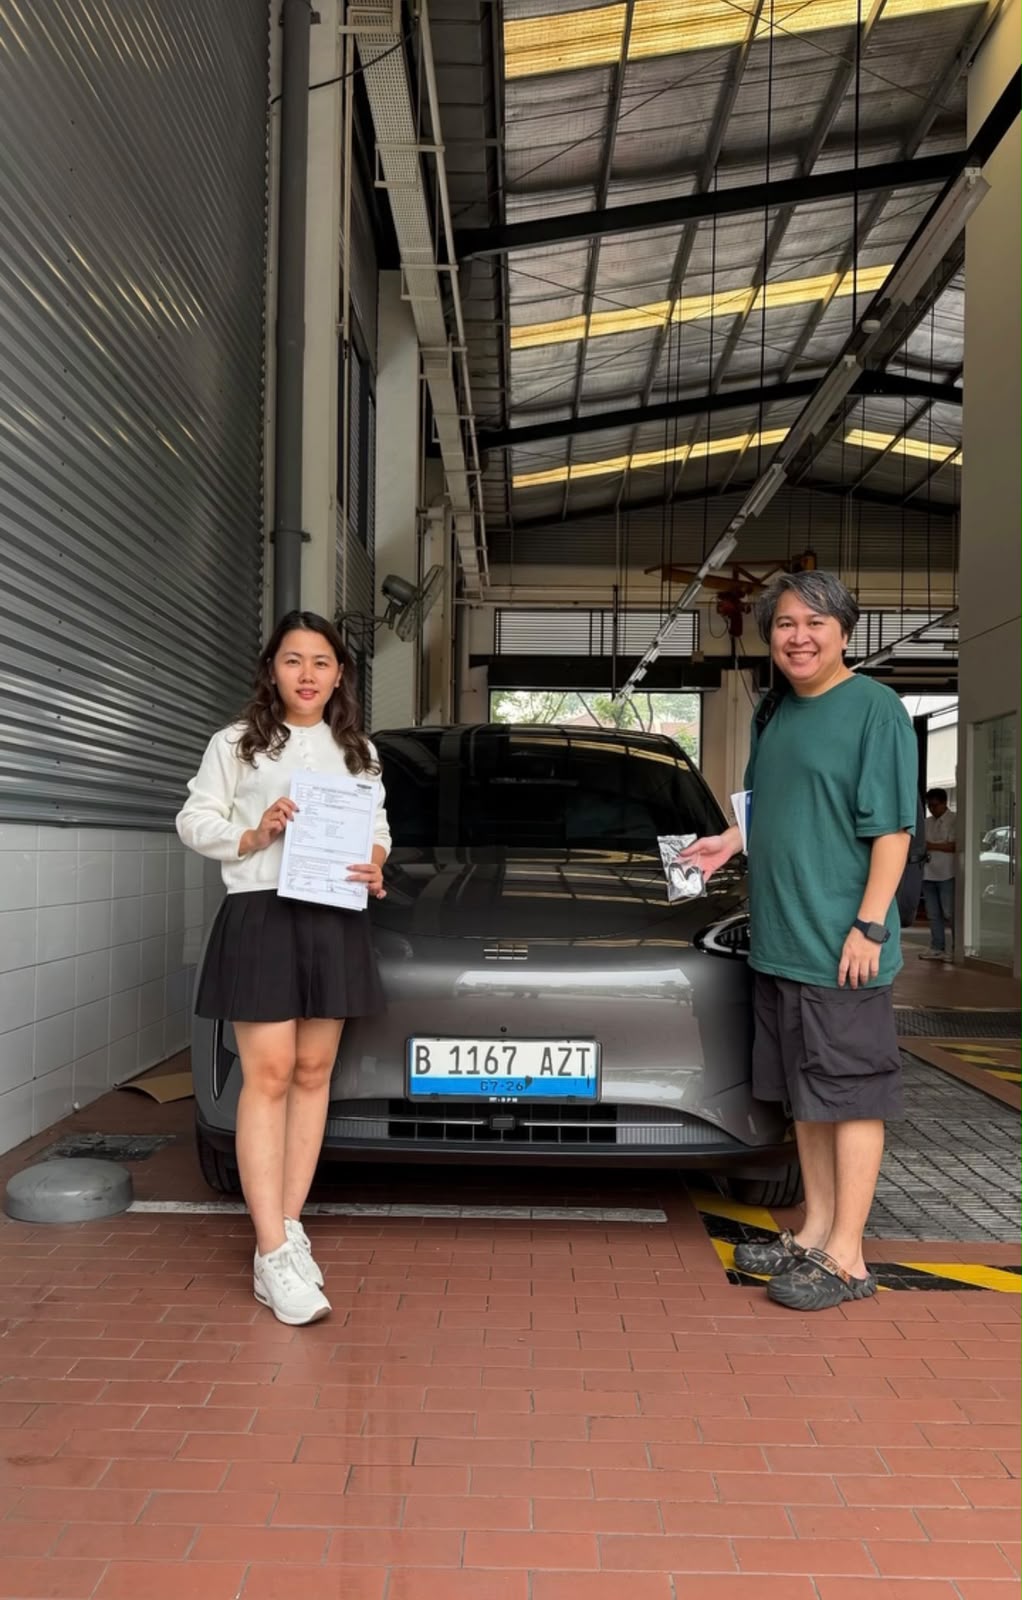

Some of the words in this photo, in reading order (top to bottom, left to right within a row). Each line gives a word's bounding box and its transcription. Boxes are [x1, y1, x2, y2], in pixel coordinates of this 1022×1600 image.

[415, 1045, 431, 1075] B
[448, 1045, 517, 1075] 1167
[540, 1047, 591, 1077] AZT
